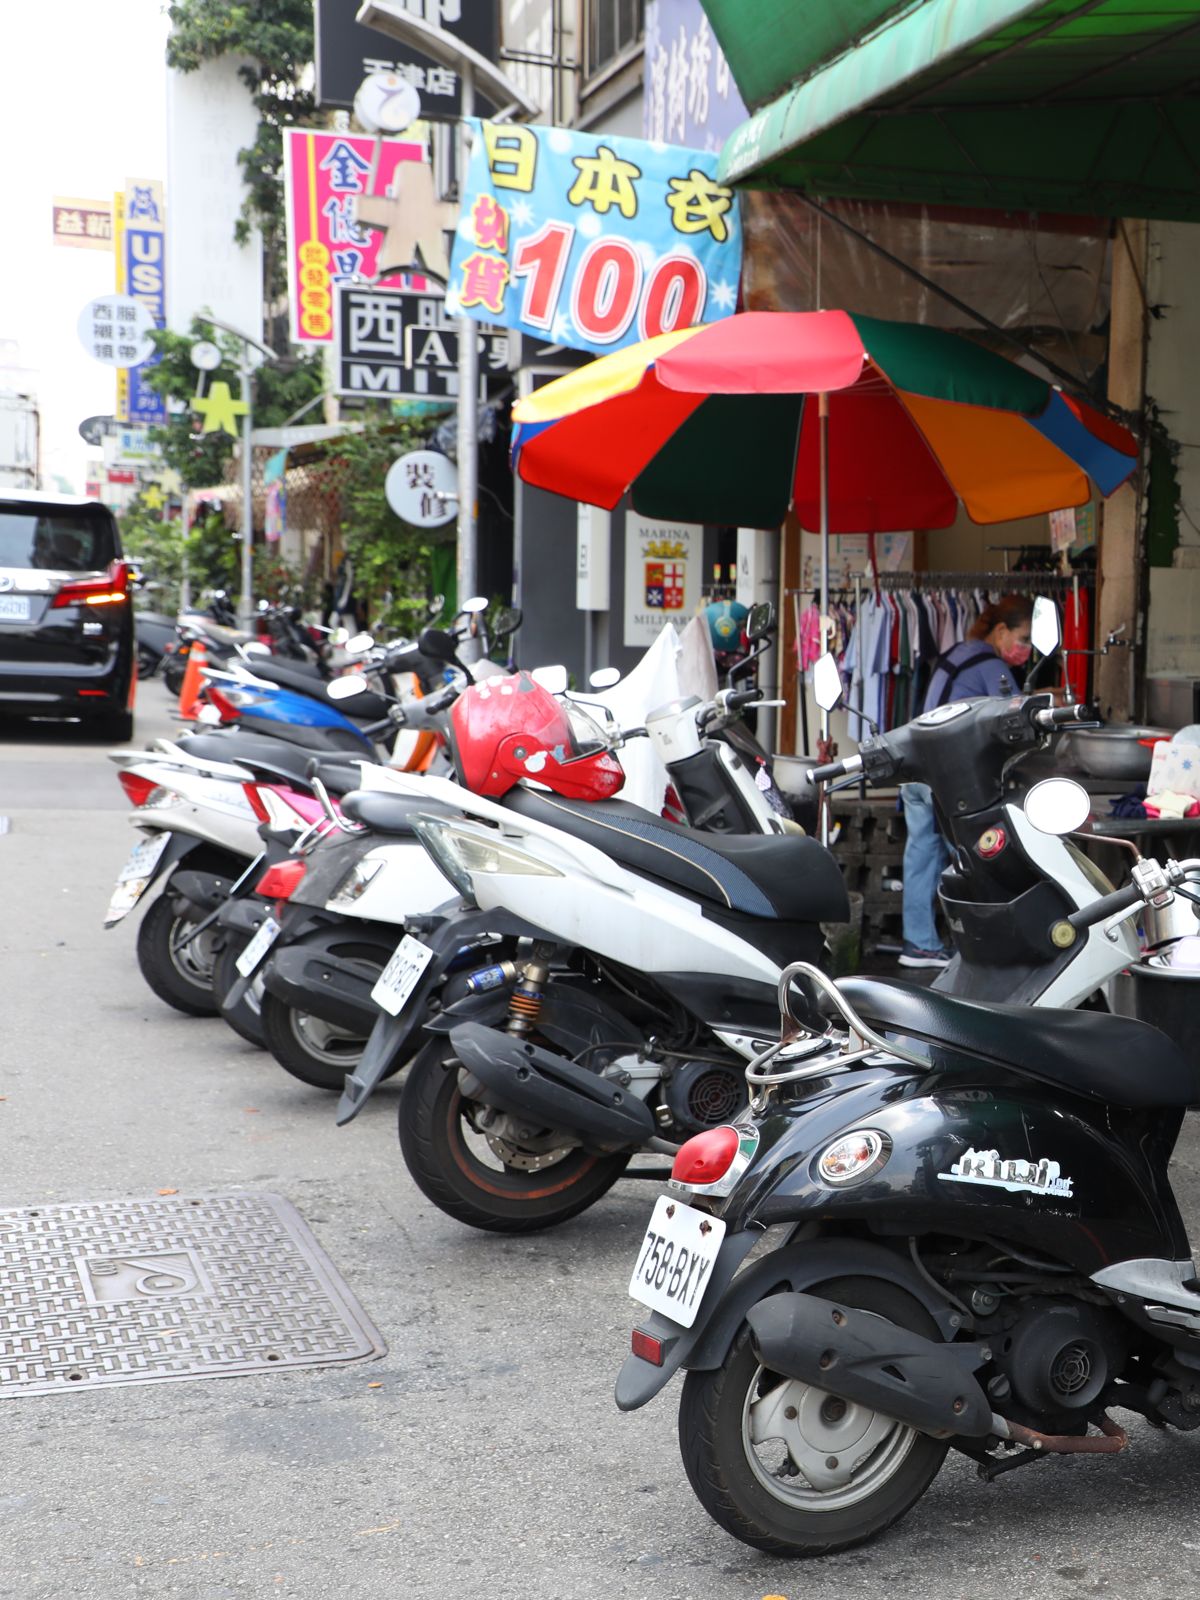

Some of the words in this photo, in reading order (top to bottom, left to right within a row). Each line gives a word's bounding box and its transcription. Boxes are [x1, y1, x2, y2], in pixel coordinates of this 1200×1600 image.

[481, 120, 731, 241] 日本衣
[512, 221, 706, 343] 100
[640, 528, 690, 541] MARINA
[634, 615, 693, 626] MILITAR
